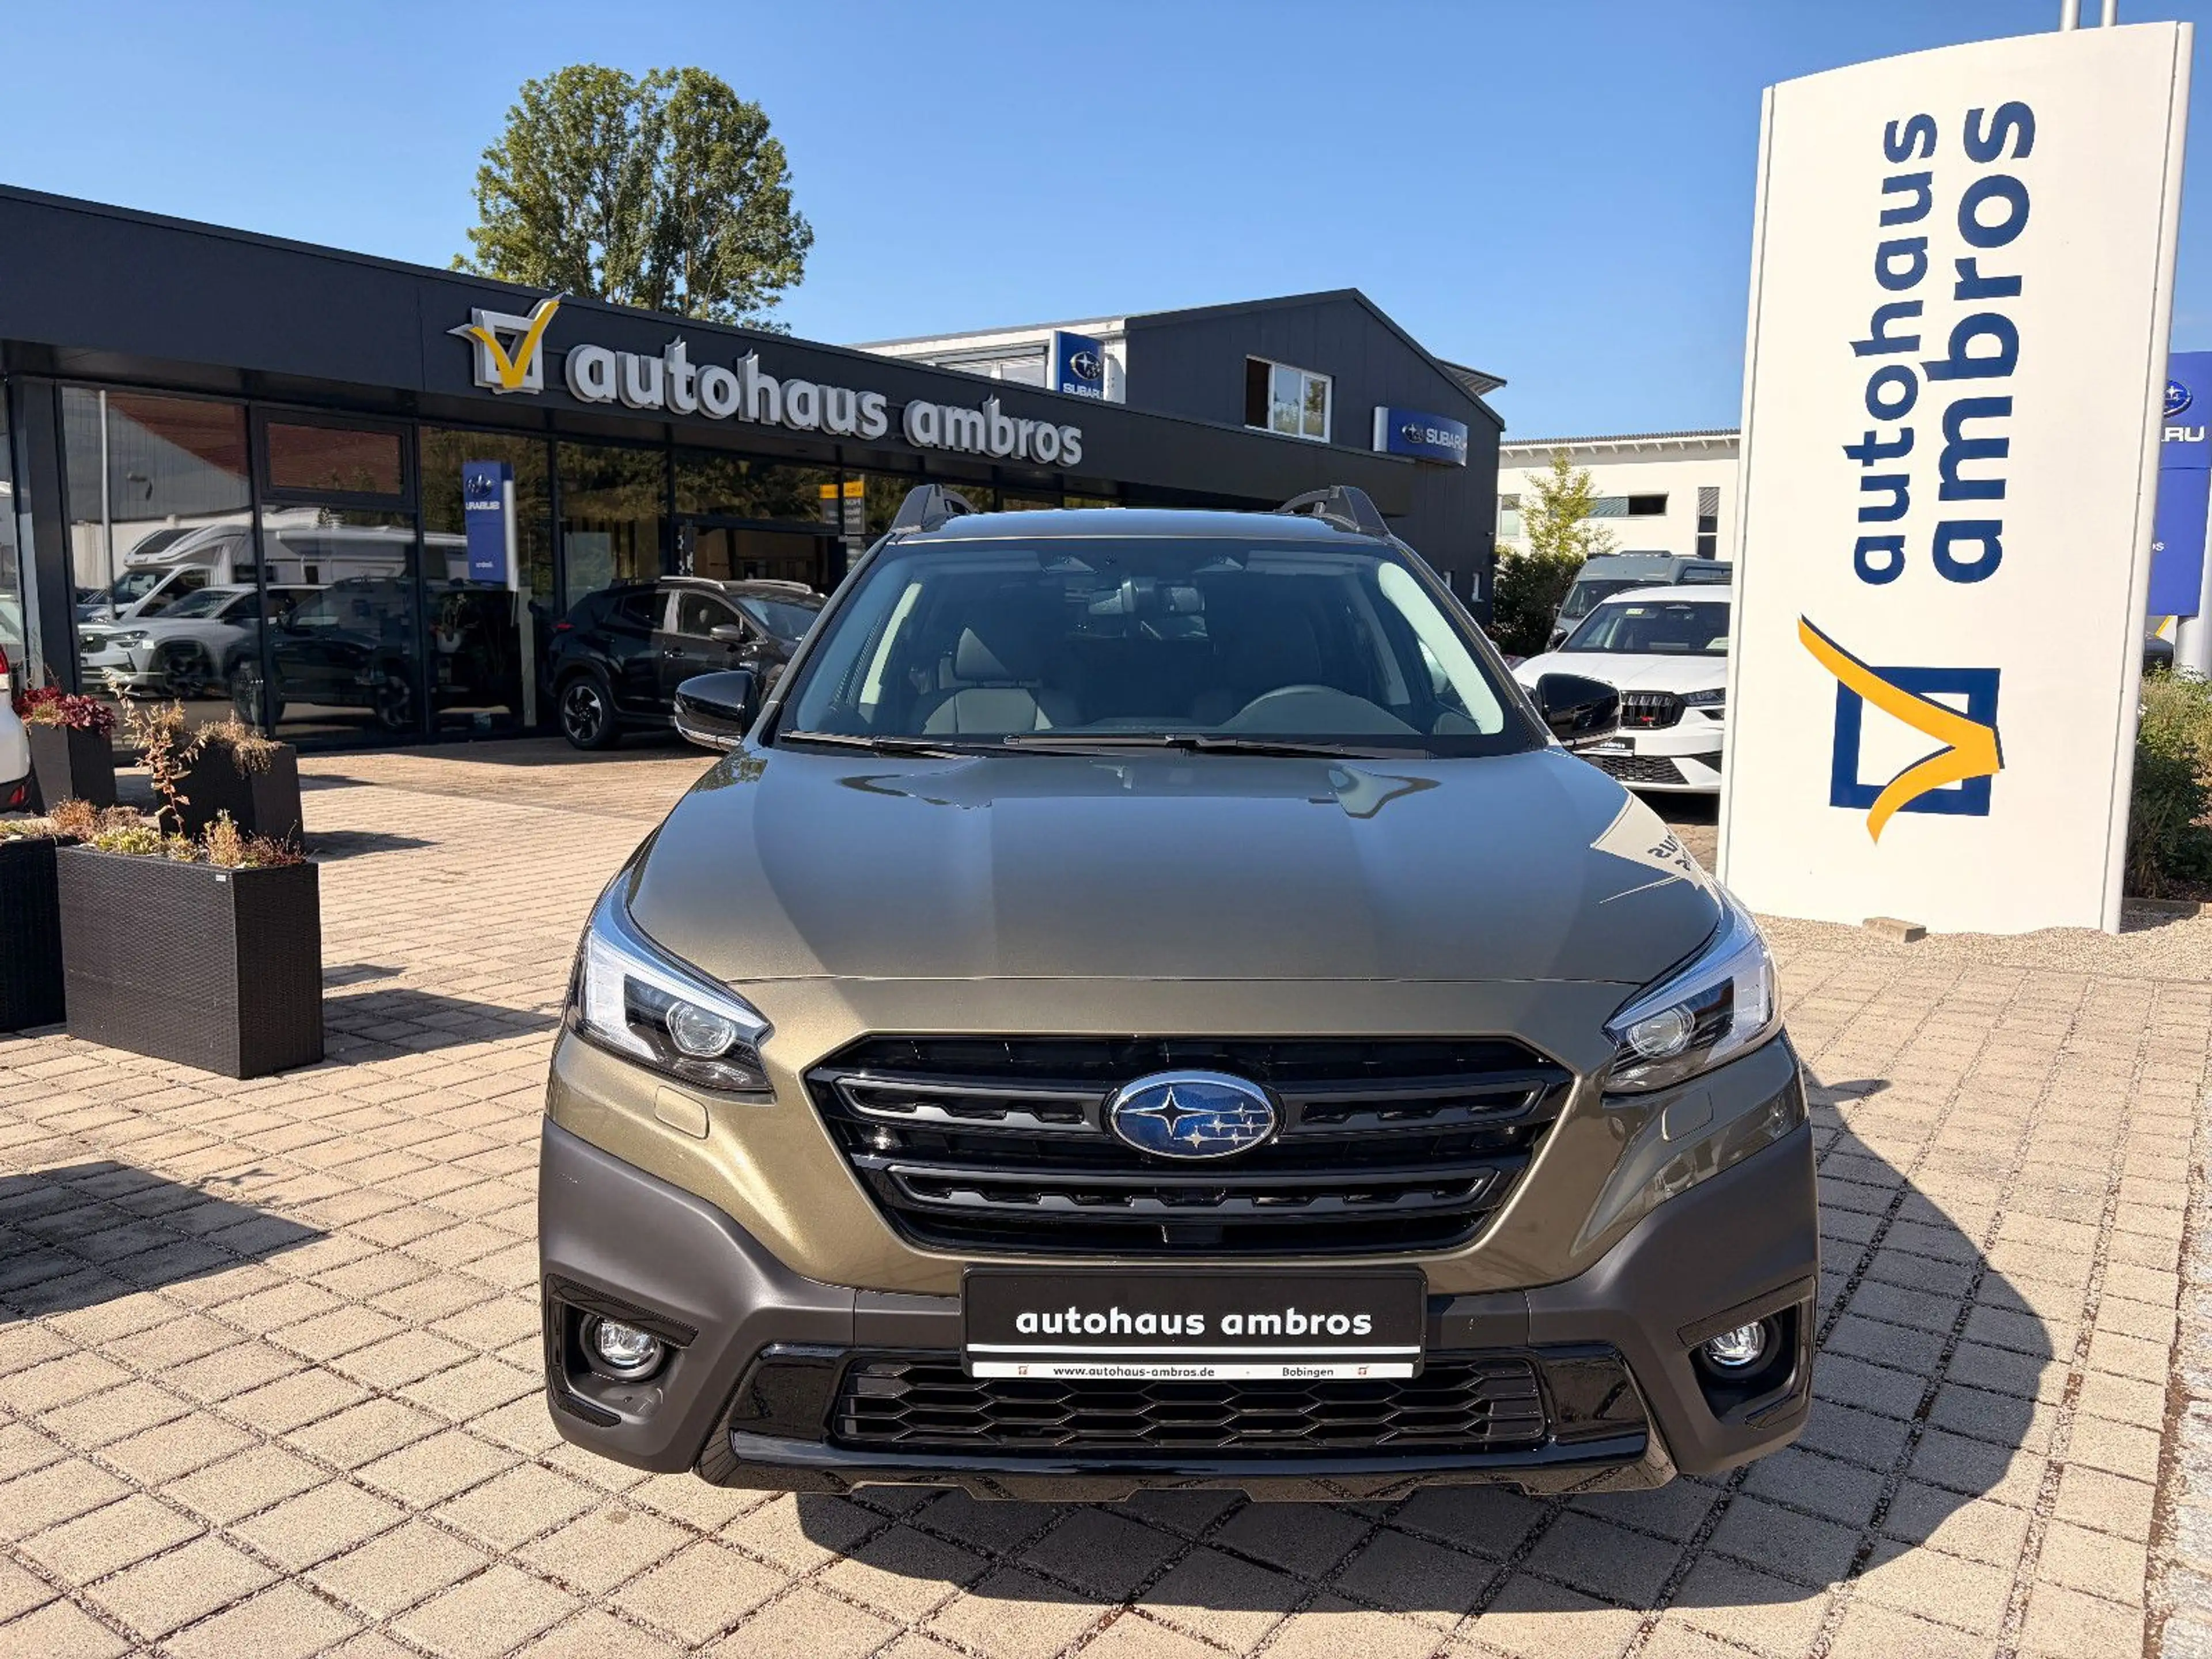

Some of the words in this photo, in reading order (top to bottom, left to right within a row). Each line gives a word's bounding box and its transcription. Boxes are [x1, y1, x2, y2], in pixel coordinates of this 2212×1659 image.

[566, 335, 888, 440] autohaus
[903, 393, 1082, 467] ambros
[1842, 113, 1937, 585] autohaus
[1919, 100, 2036, 584] ambros
[1016, 1306, 1205, 1335] autohaus
[1221, 1306, 1372, 1335] ambros
[1053, 1366, 1215, 1377] www.autohaus-ambros.de
[1282, 1367, 1334, 1378] Bobingen
